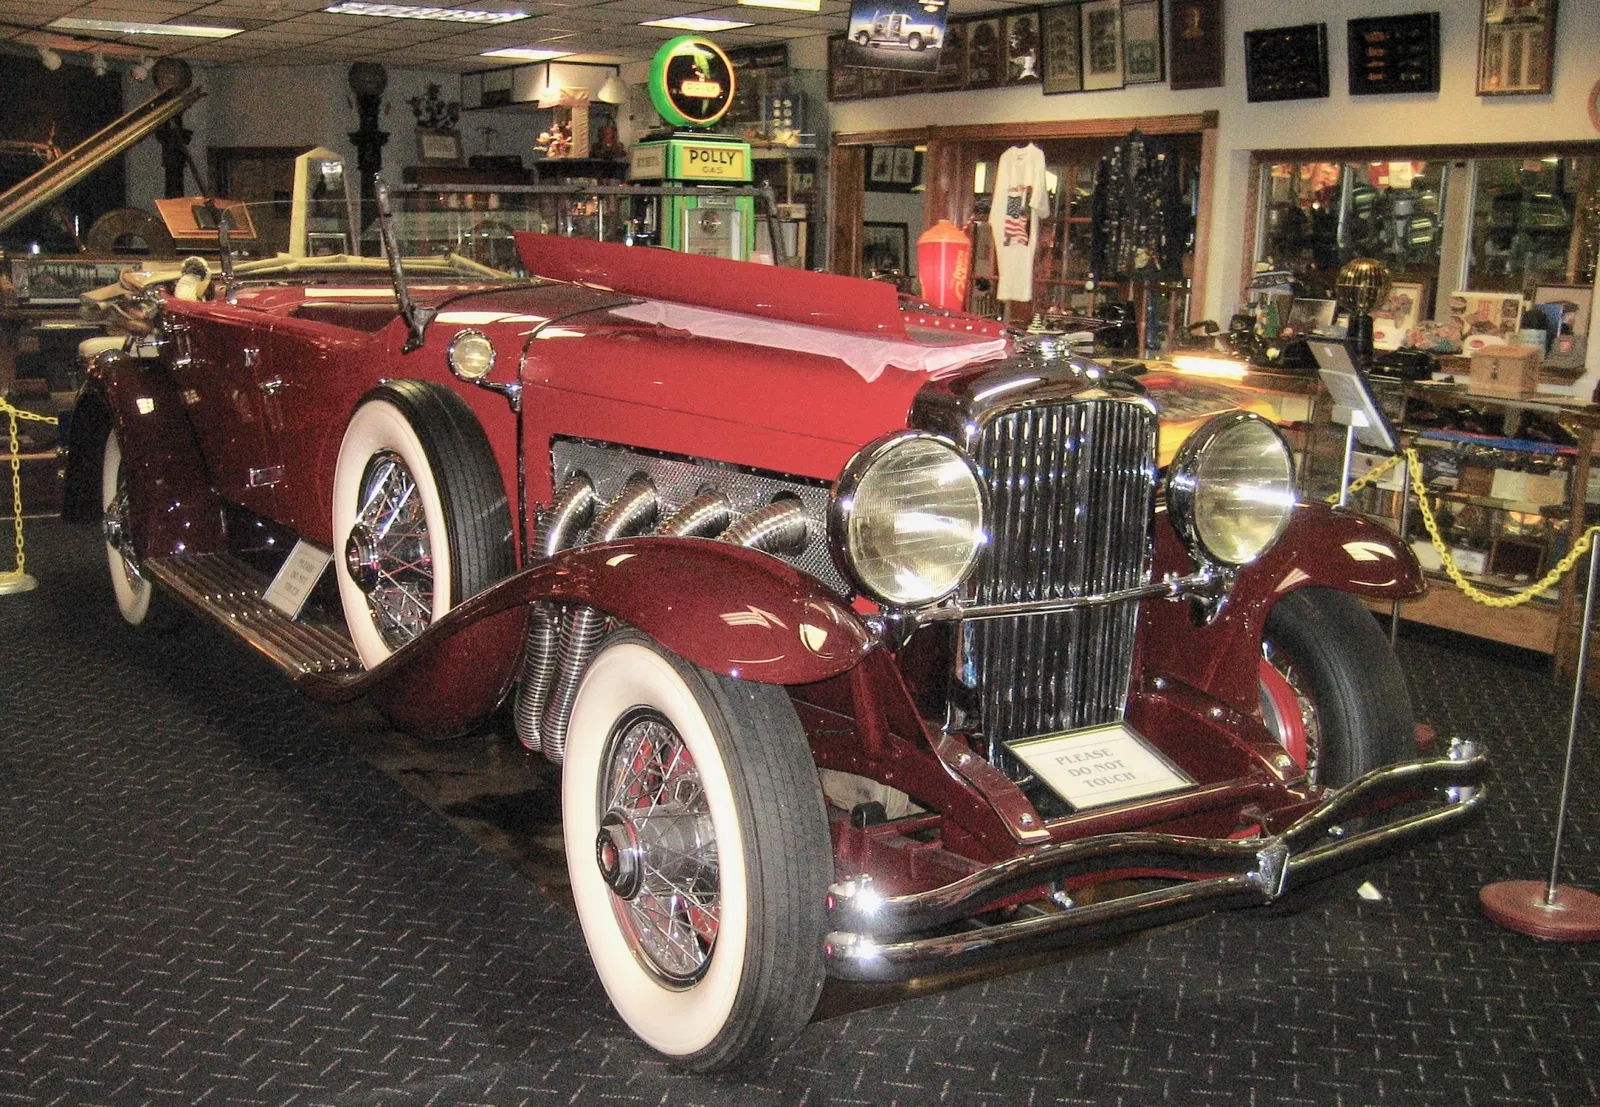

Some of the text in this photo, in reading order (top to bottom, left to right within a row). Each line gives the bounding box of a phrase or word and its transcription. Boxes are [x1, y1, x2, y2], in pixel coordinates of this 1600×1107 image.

[689, 149, 736, 165] POLLY
[702, 166, 723, 174] GAS
[1055, 748, 1114, 766] PLEASE
[1068, 760, 1126, 777] DO NOT
[1083, 771, 1136, 788] TOUCH
